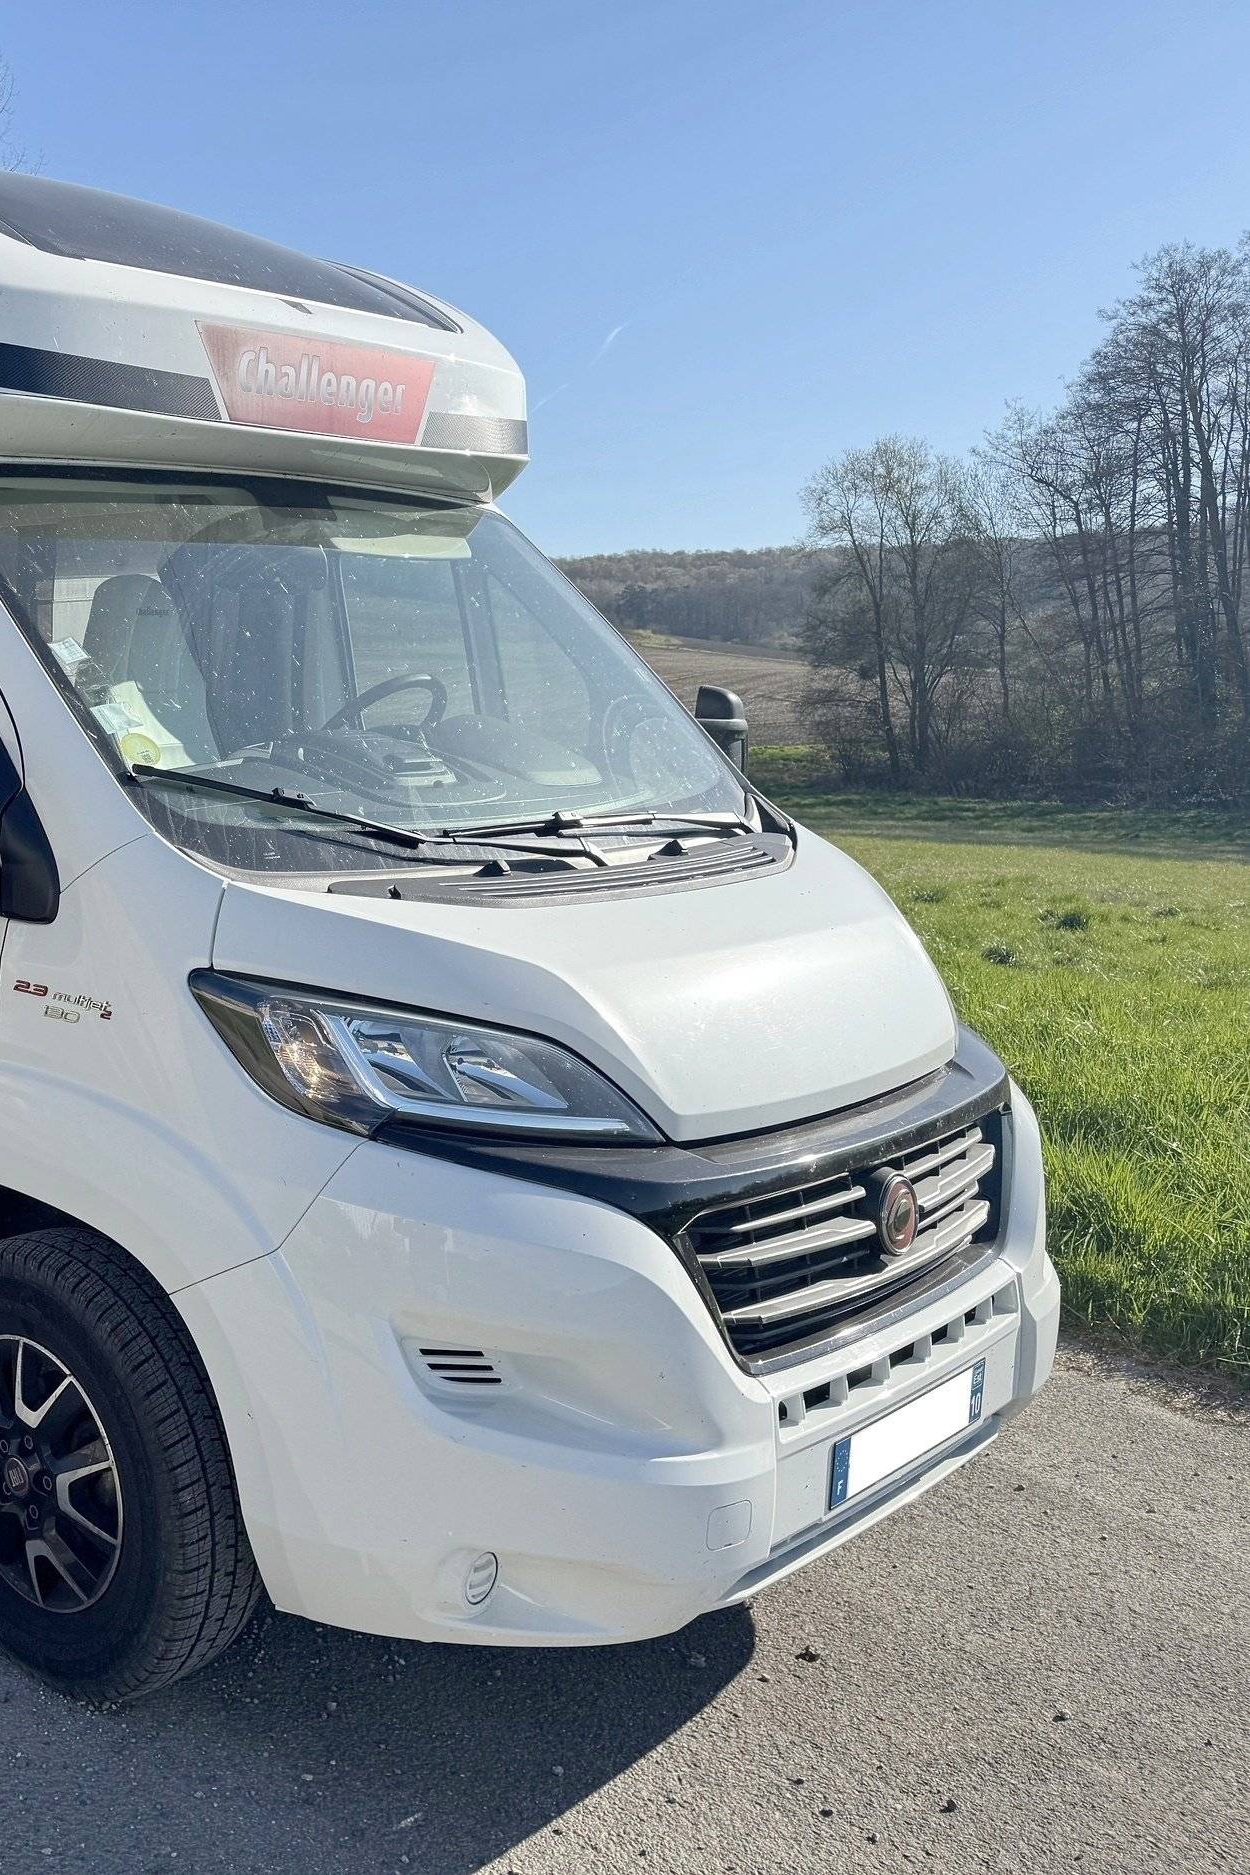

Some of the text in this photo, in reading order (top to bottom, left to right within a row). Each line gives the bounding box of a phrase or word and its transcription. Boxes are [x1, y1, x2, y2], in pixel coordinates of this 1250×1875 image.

[237, 346, 406, 424] Challenger
[971, 1392, 981, 1417] 10
[836, 1479, 844, 1496] F
